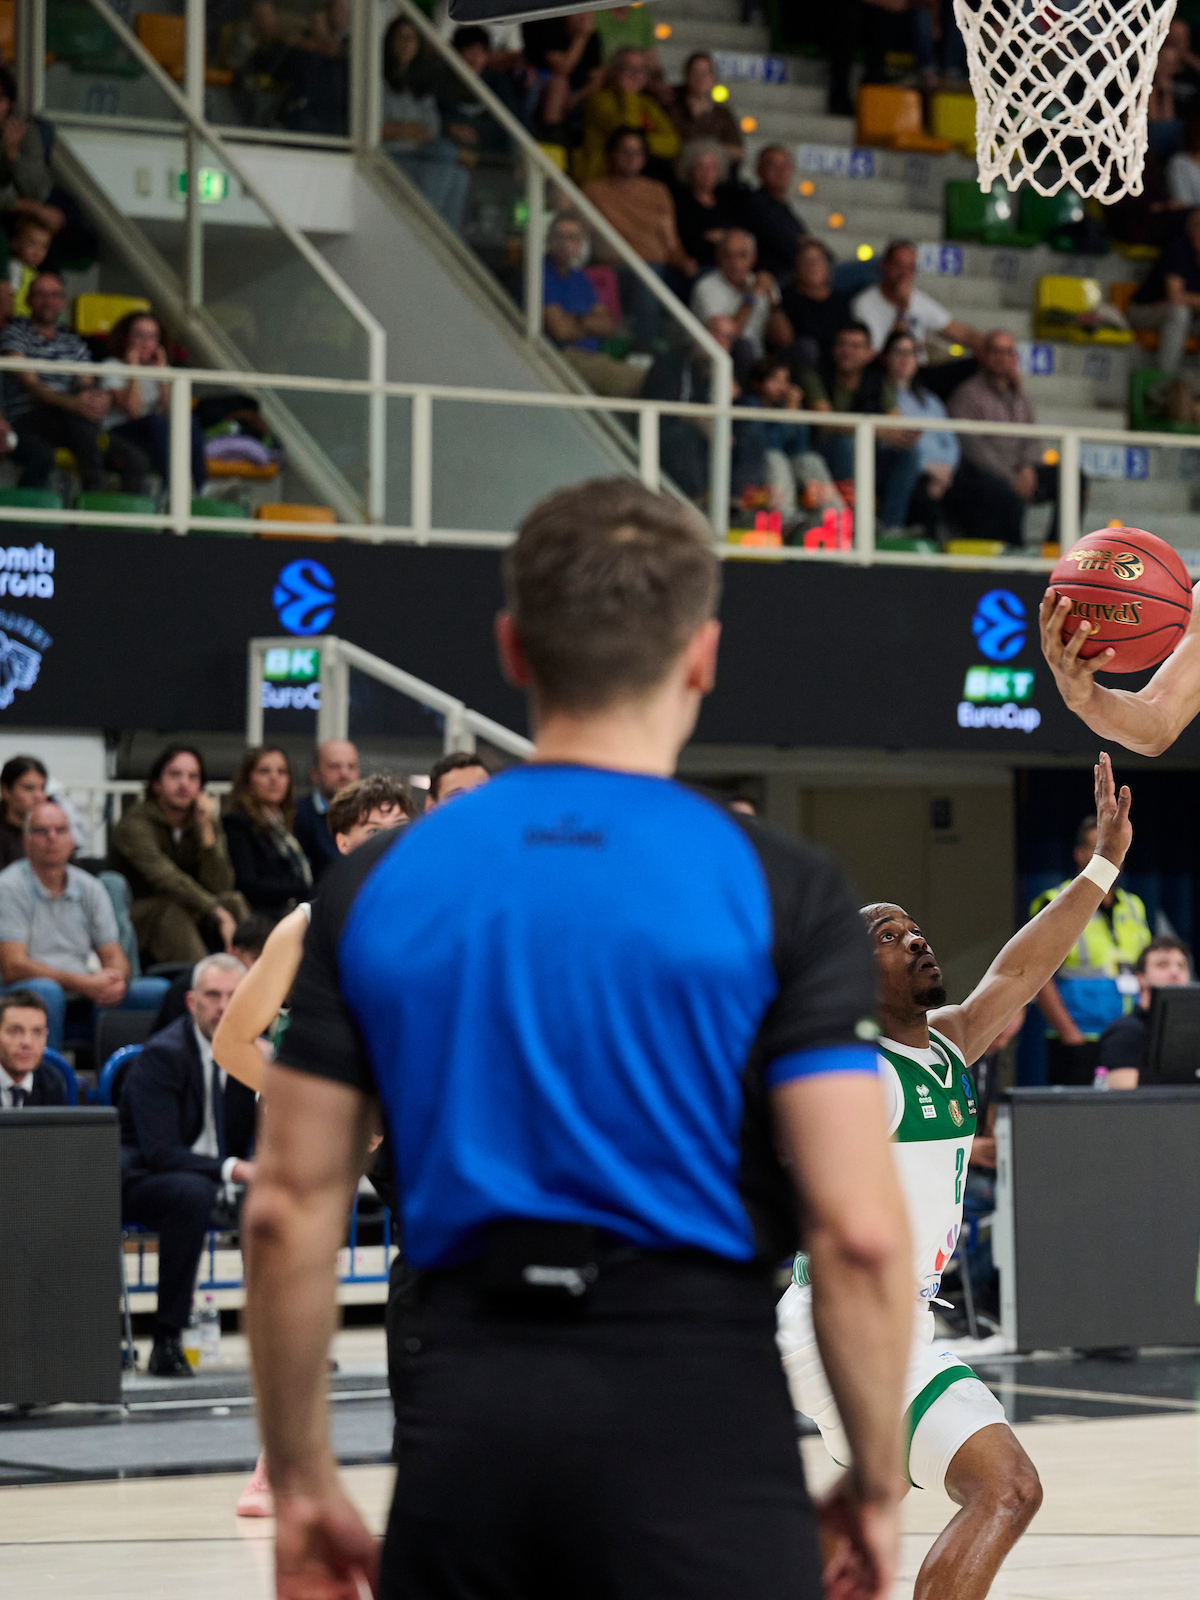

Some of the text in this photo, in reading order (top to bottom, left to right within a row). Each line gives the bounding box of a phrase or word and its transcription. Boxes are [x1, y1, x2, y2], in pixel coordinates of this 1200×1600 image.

[1068, 600, 1142, 625] SPALDI
[265, 648, 317, 676] BK
[966, 671, 1034, 699] BKT
[957, 701, 1041, 733] EuroCup
[955, 1148, 965, 1205] 2
